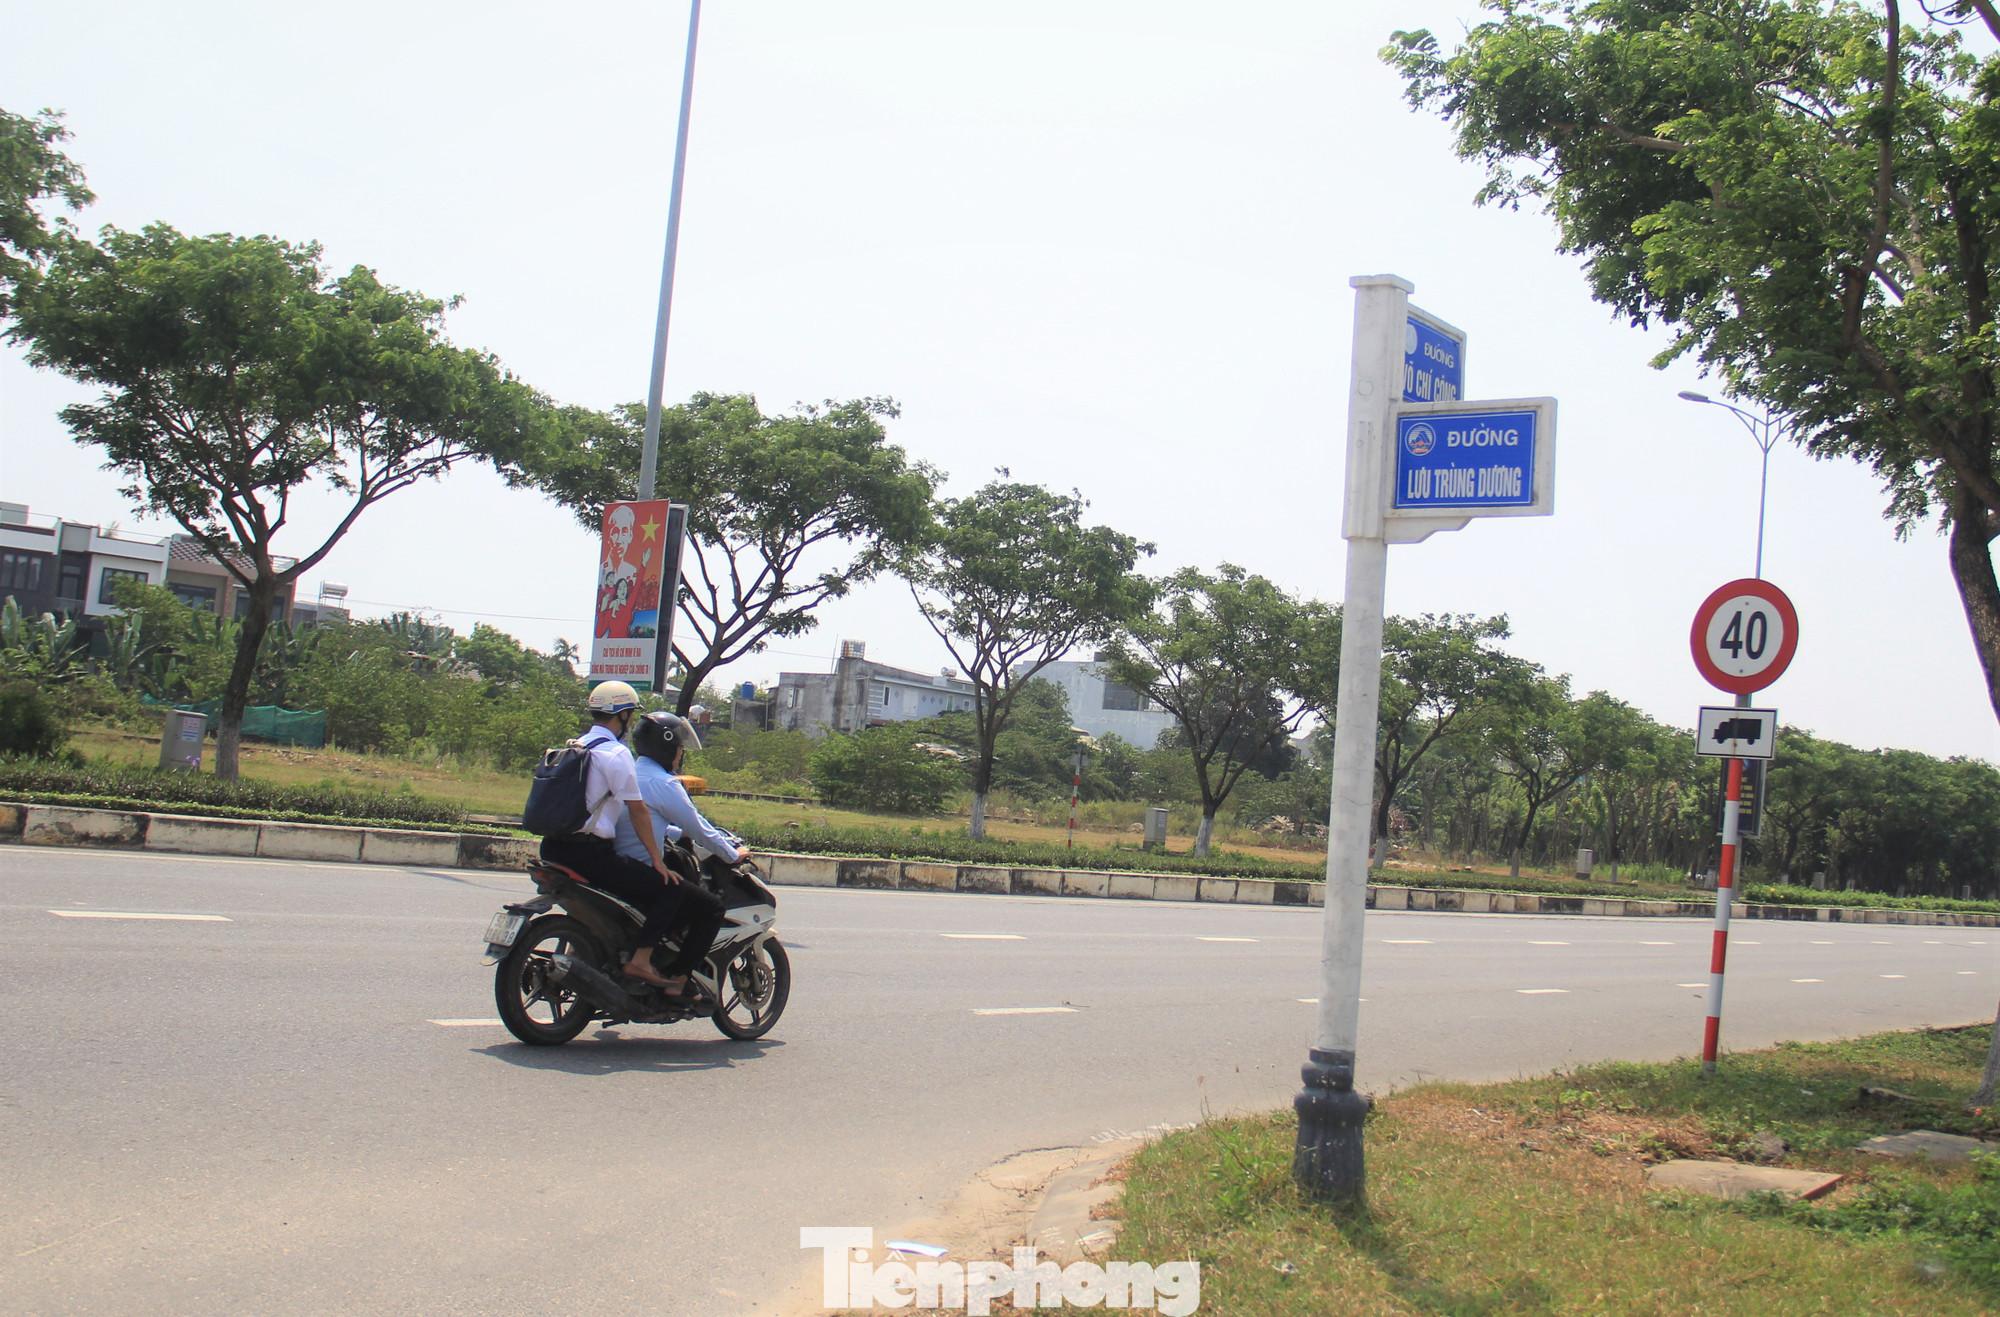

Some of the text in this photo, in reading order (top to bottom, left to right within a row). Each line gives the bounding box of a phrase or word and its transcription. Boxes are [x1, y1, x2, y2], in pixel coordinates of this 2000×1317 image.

[1424, 341, 1454, 368] ĐƯỜNG
[1416, 369, 1432, 401] CHÍ
[1433, 375, 1456, 402] CÔNG
[1447, 423, 1518, 447] ĐƯỜNG
[1407, 467, 1431, 499] LƯU
[1434, 462, 1475, 498] TRÙNG
[1720, 611, 1767, 660] 40
